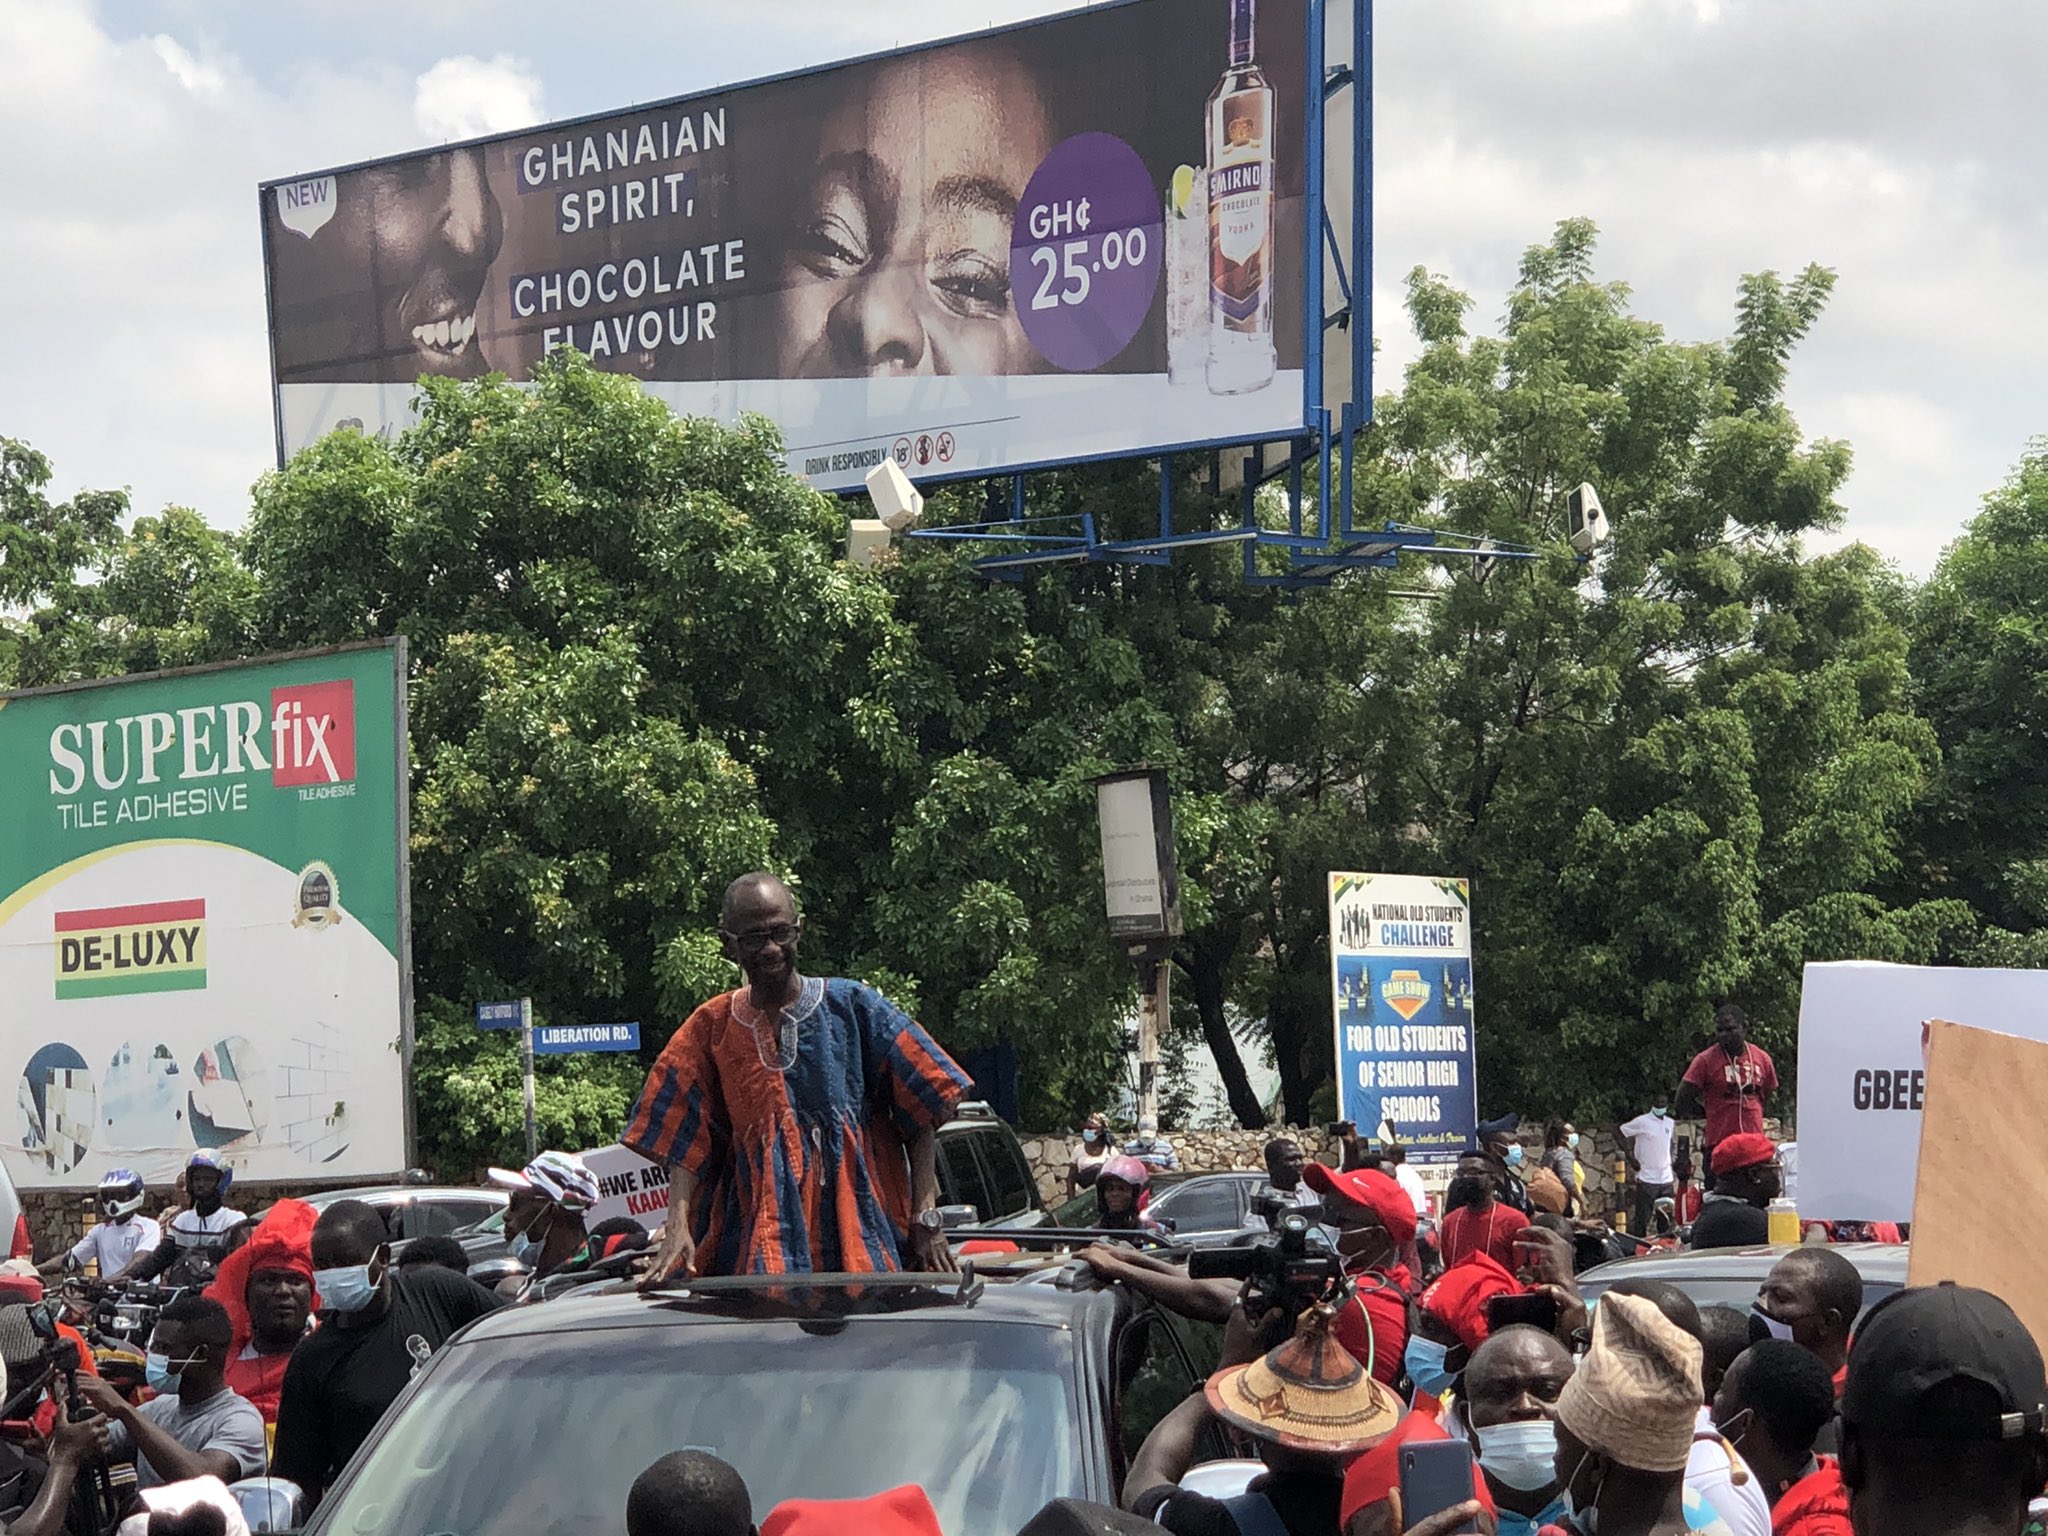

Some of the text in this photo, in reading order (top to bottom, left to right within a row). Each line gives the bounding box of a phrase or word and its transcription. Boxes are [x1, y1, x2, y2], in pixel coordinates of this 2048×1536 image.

[523, 108, 725, 186] GHANAIAN
[286, 180, 328, 209] NEW
[562, 172, 693, 233] SPIRIT,
[514, 239, 745, 317] CHOCOLATE
[1030, 227, 1147, 311] 25.00
[805, 457, 831, 475] DRINK
[832, 447, 887, 471] RESPONSIBLY
[298, 784, 356, 801] TILE ADHESIVE
[57, 784, 248, 829] TILE ADHESIVE
[1372, 904, 1408, 921] NATIONAL
[1410, 905, 1423, 921] OLD
[1381, 923, 1454, 946] CHALLENGE
[61, 927, 200, 973] DE-LUXY
[542, 1026, 632, 1044] LIBERATION RD.
[1346, 1025, 1467, 1052] FOR OLD STUDENTS
[1359, 1060, 1459, 1087] OF SENIOR HIGH
[1381, 1096, 1440, 1122] SCHOOLS
[599, 1171, 638, 1198] #WE
